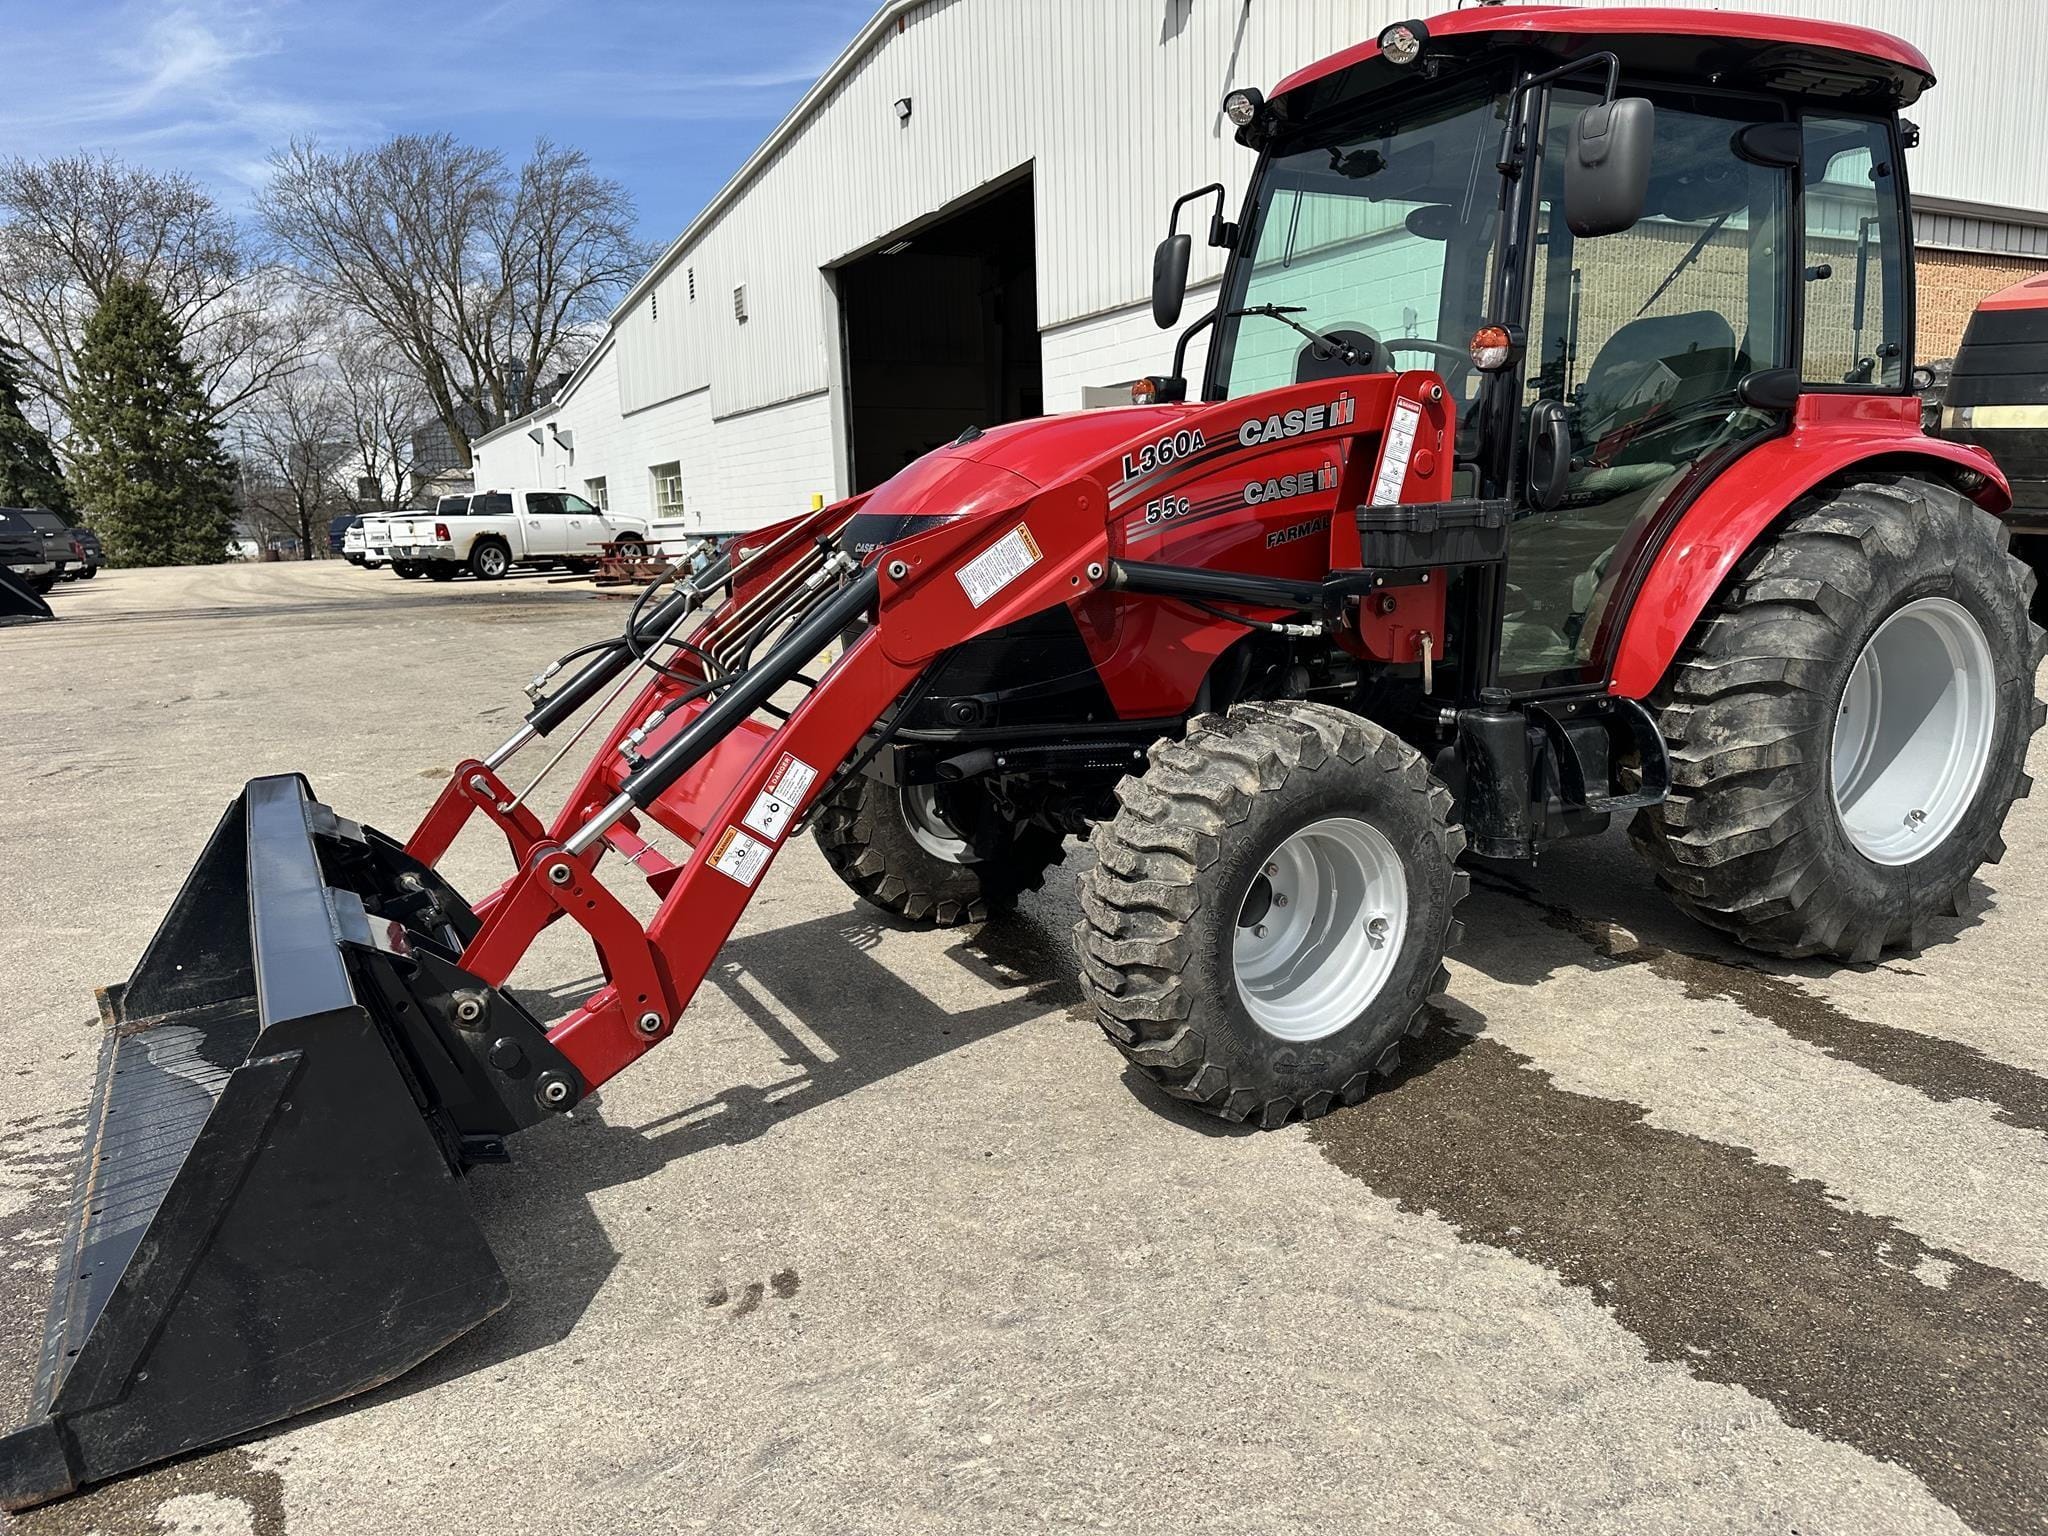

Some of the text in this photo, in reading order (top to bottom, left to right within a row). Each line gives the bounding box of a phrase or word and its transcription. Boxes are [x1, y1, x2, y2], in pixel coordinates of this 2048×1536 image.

[1238, 405, 1325, 447] CASE
[1122, 429, 1206, 483] L360A
[1244, 472, 1314, 506] CASE
[855, 542, 875, 553] CASE
[772, 757, 791, 785] DANGER
